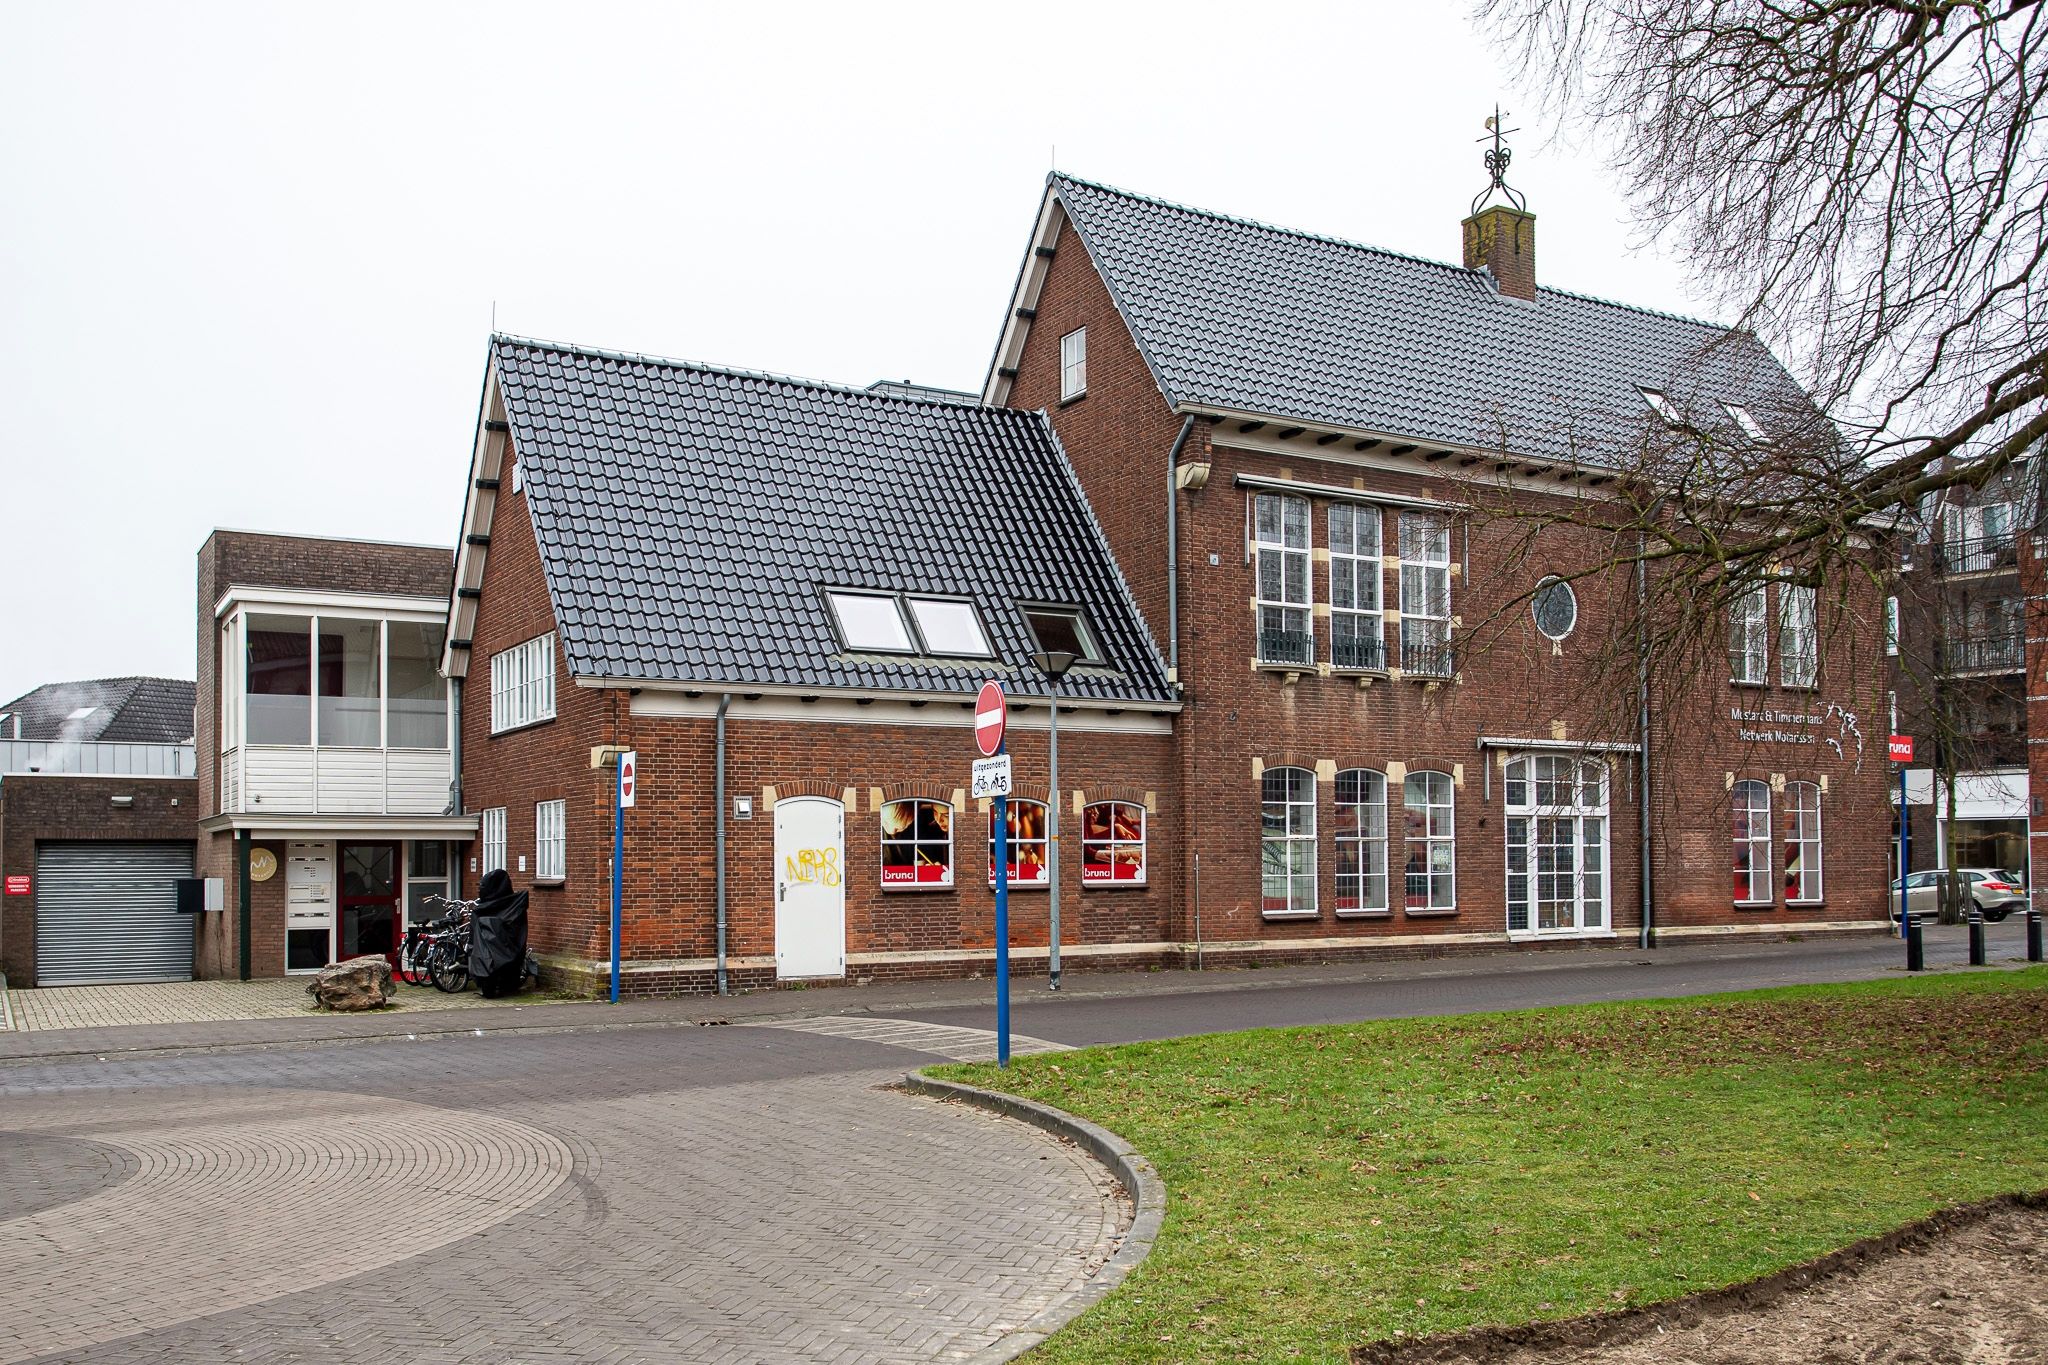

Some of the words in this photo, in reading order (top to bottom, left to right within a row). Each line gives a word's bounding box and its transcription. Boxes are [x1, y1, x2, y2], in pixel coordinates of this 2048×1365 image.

[1765, 710, 1773, 722] &
[1740, 728, 1773, 742] Netwerk
[974, 760, 1006, 772] uitgezonderd
[884, 870, 913, 879] bruna
[1084, 868, 1110, 877] bruna
